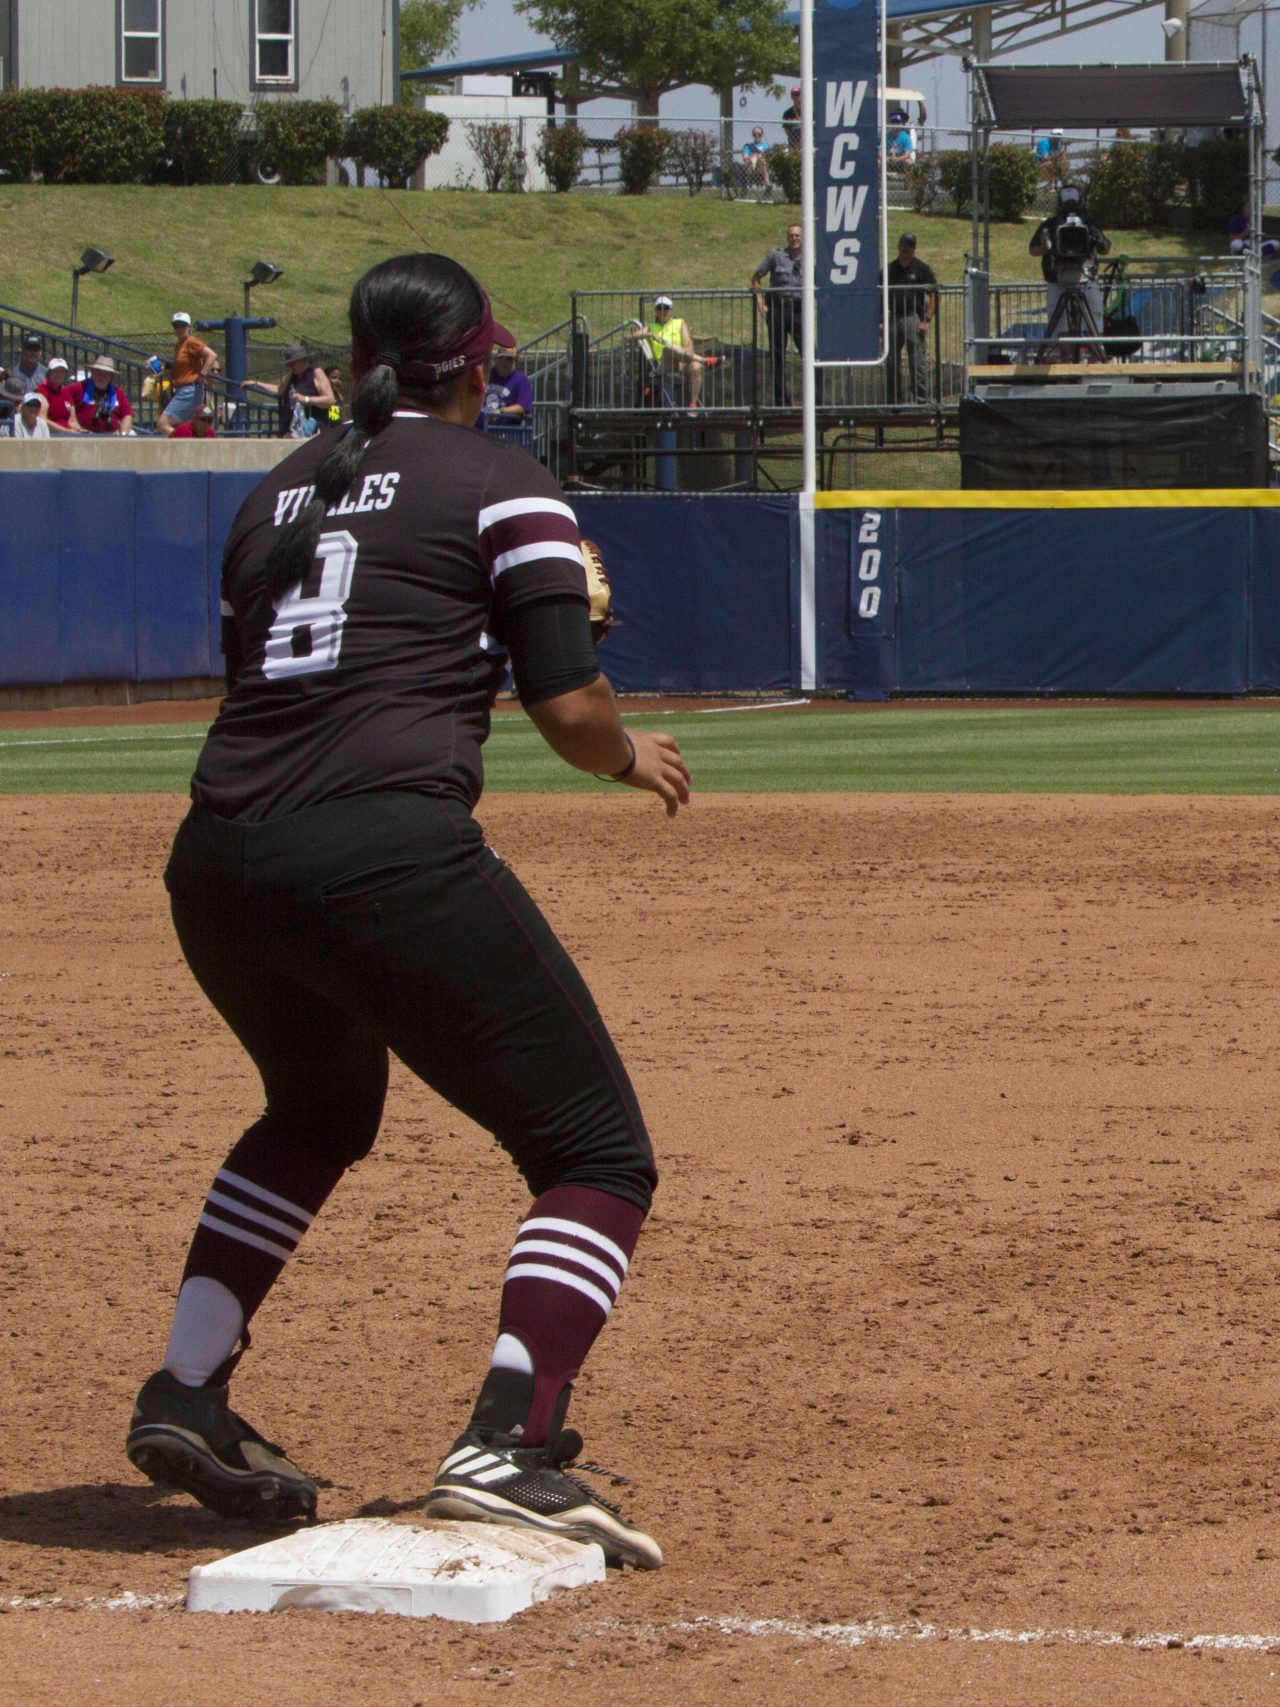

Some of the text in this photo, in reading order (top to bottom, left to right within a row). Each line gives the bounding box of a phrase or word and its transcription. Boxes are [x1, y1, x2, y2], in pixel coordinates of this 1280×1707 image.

[825, 80, 868, 285] WCWS
[274, 472, 400, 526] VILES
[261, 529, 359, 680] 8
[858, 511, 882, 619] 200
